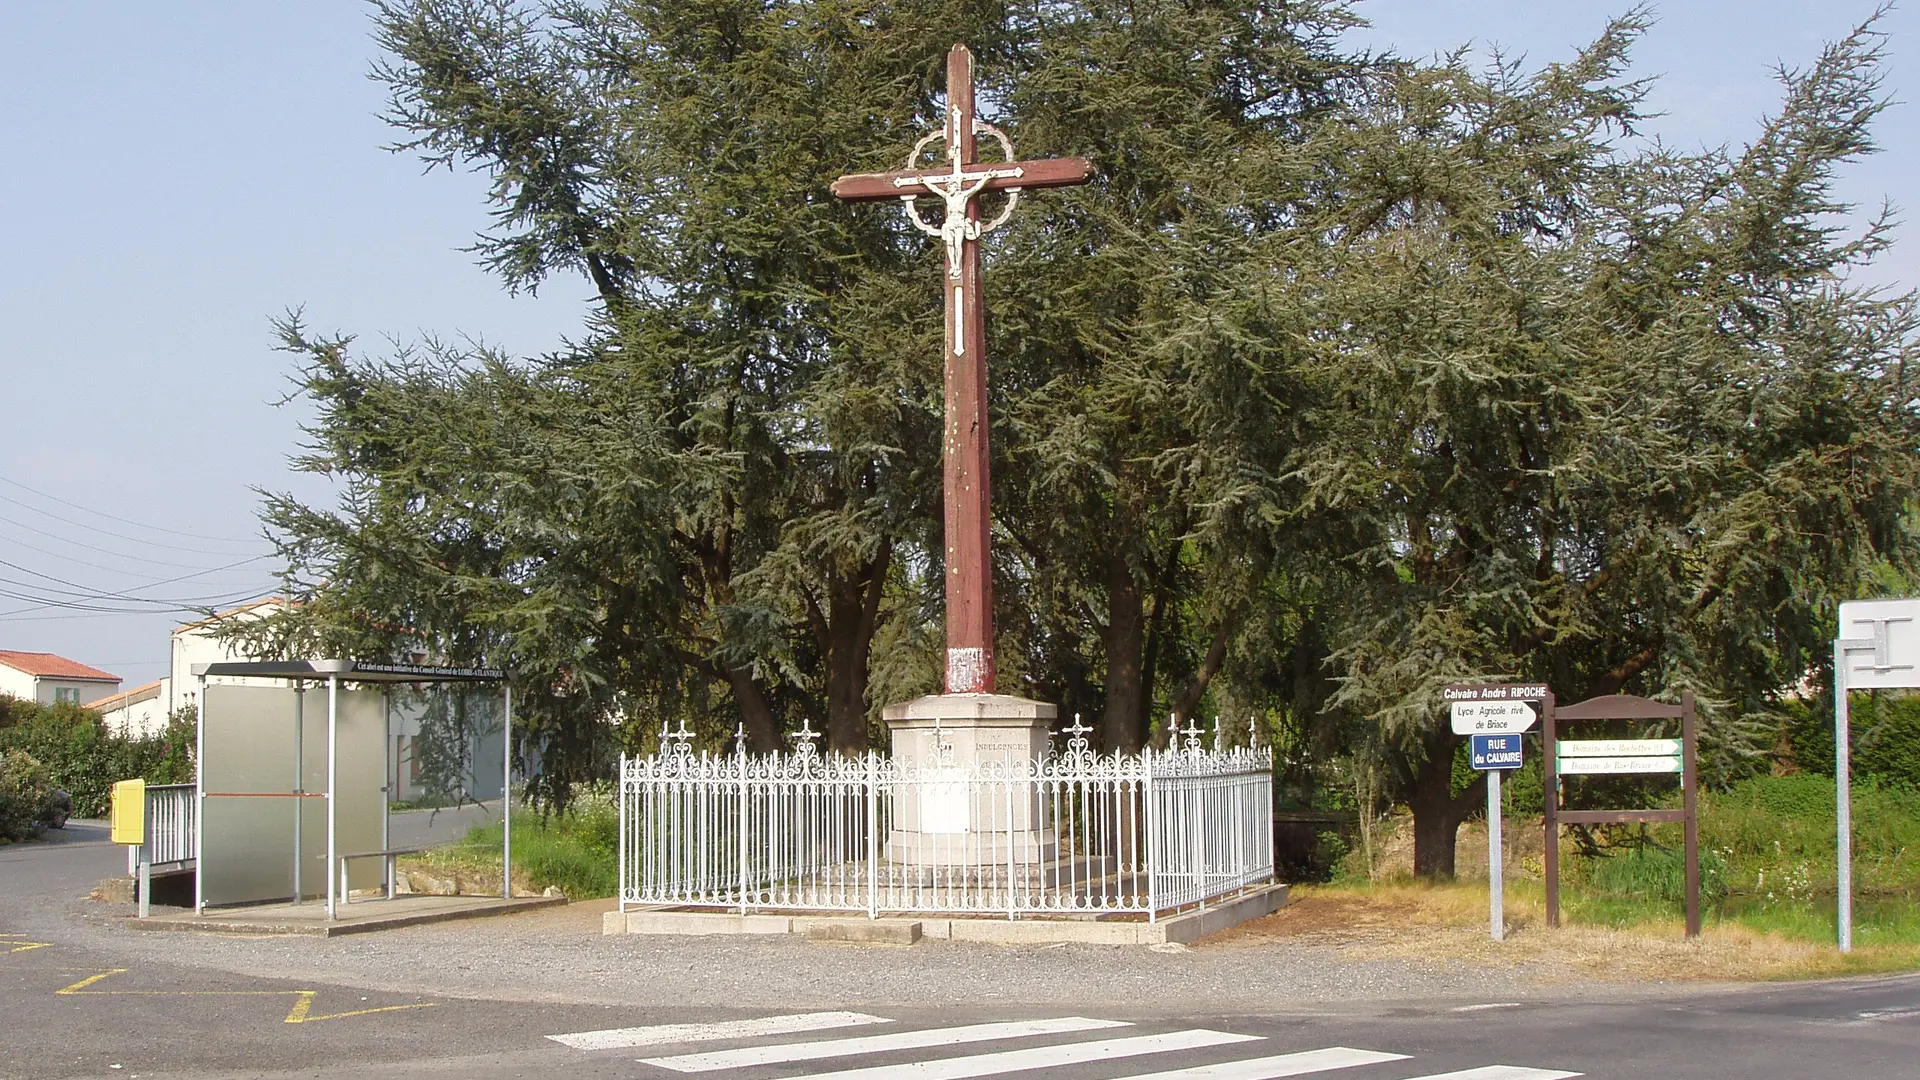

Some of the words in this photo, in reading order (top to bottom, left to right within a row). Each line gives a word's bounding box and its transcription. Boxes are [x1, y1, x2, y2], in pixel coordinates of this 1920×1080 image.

[419, 666, 435, 674] Conseil
[1444, 688, 1478, 699] Calvaire
[1481, 687, 1506, 698] André
[1511, 686, 1546, 697] RIPOCHE
[1479, 705, 1506, 717] Agricole
[1475, 721, 1485, 729] de
[1487, 739, 1506, 750] RUE
[1475, 754, 1484, 764] du
[1486, 751, 1520, 763] CALVAIRE
